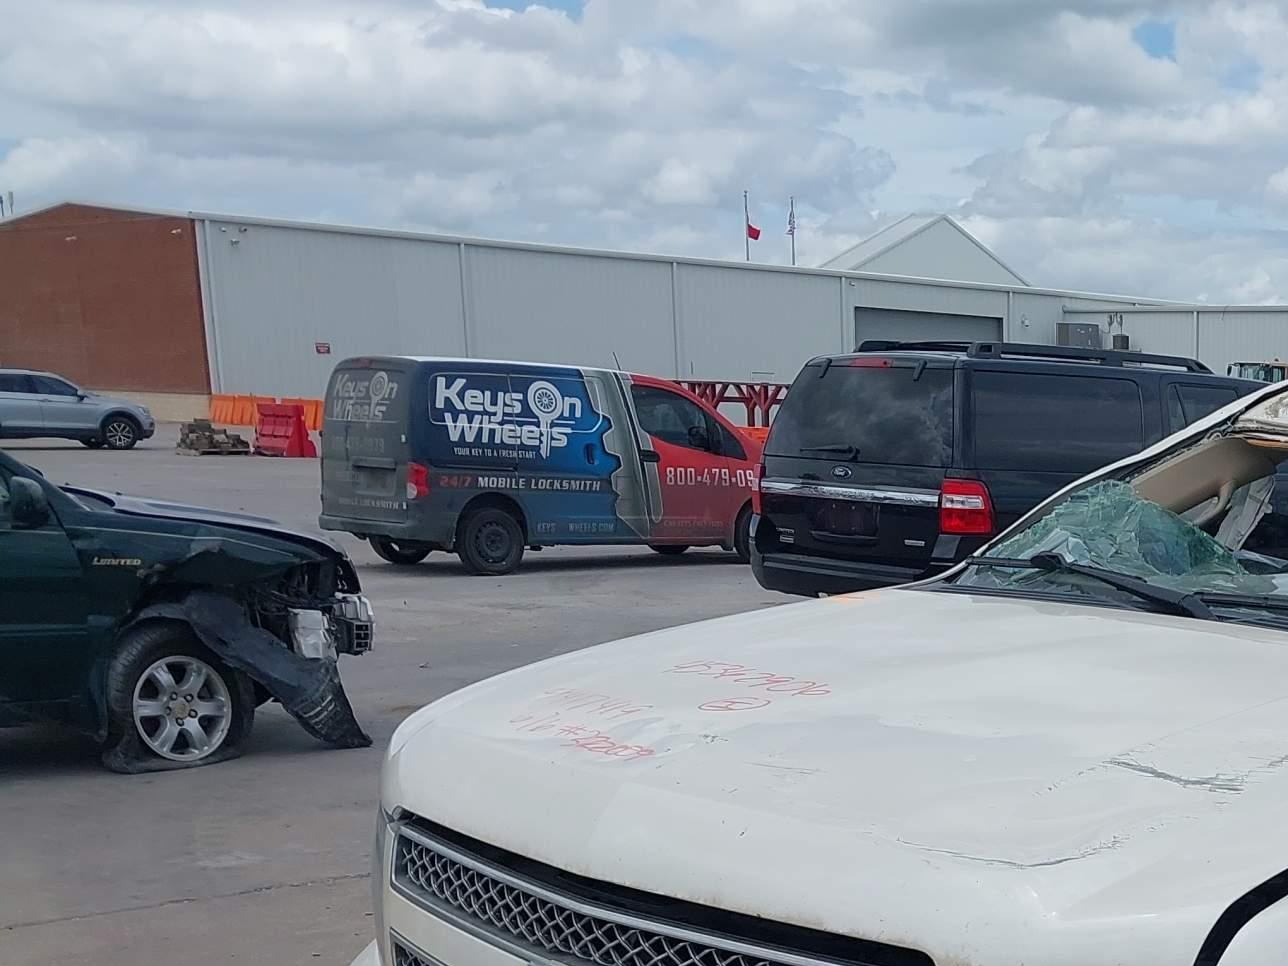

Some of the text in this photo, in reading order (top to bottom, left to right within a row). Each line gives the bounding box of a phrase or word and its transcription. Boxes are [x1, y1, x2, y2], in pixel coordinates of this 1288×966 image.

[333, 371, 398, 400] Keys On
[333, 400, 386, 420] Wheels
[435, 376, 582, 423] Keys On
[444, 412, 572, 449] Wheels
[454, 447, 536, 459] YOUR KEY TO A FRESH START
[439, 475, 601, 491] 24/7 MOBILE LOCKSMITH
